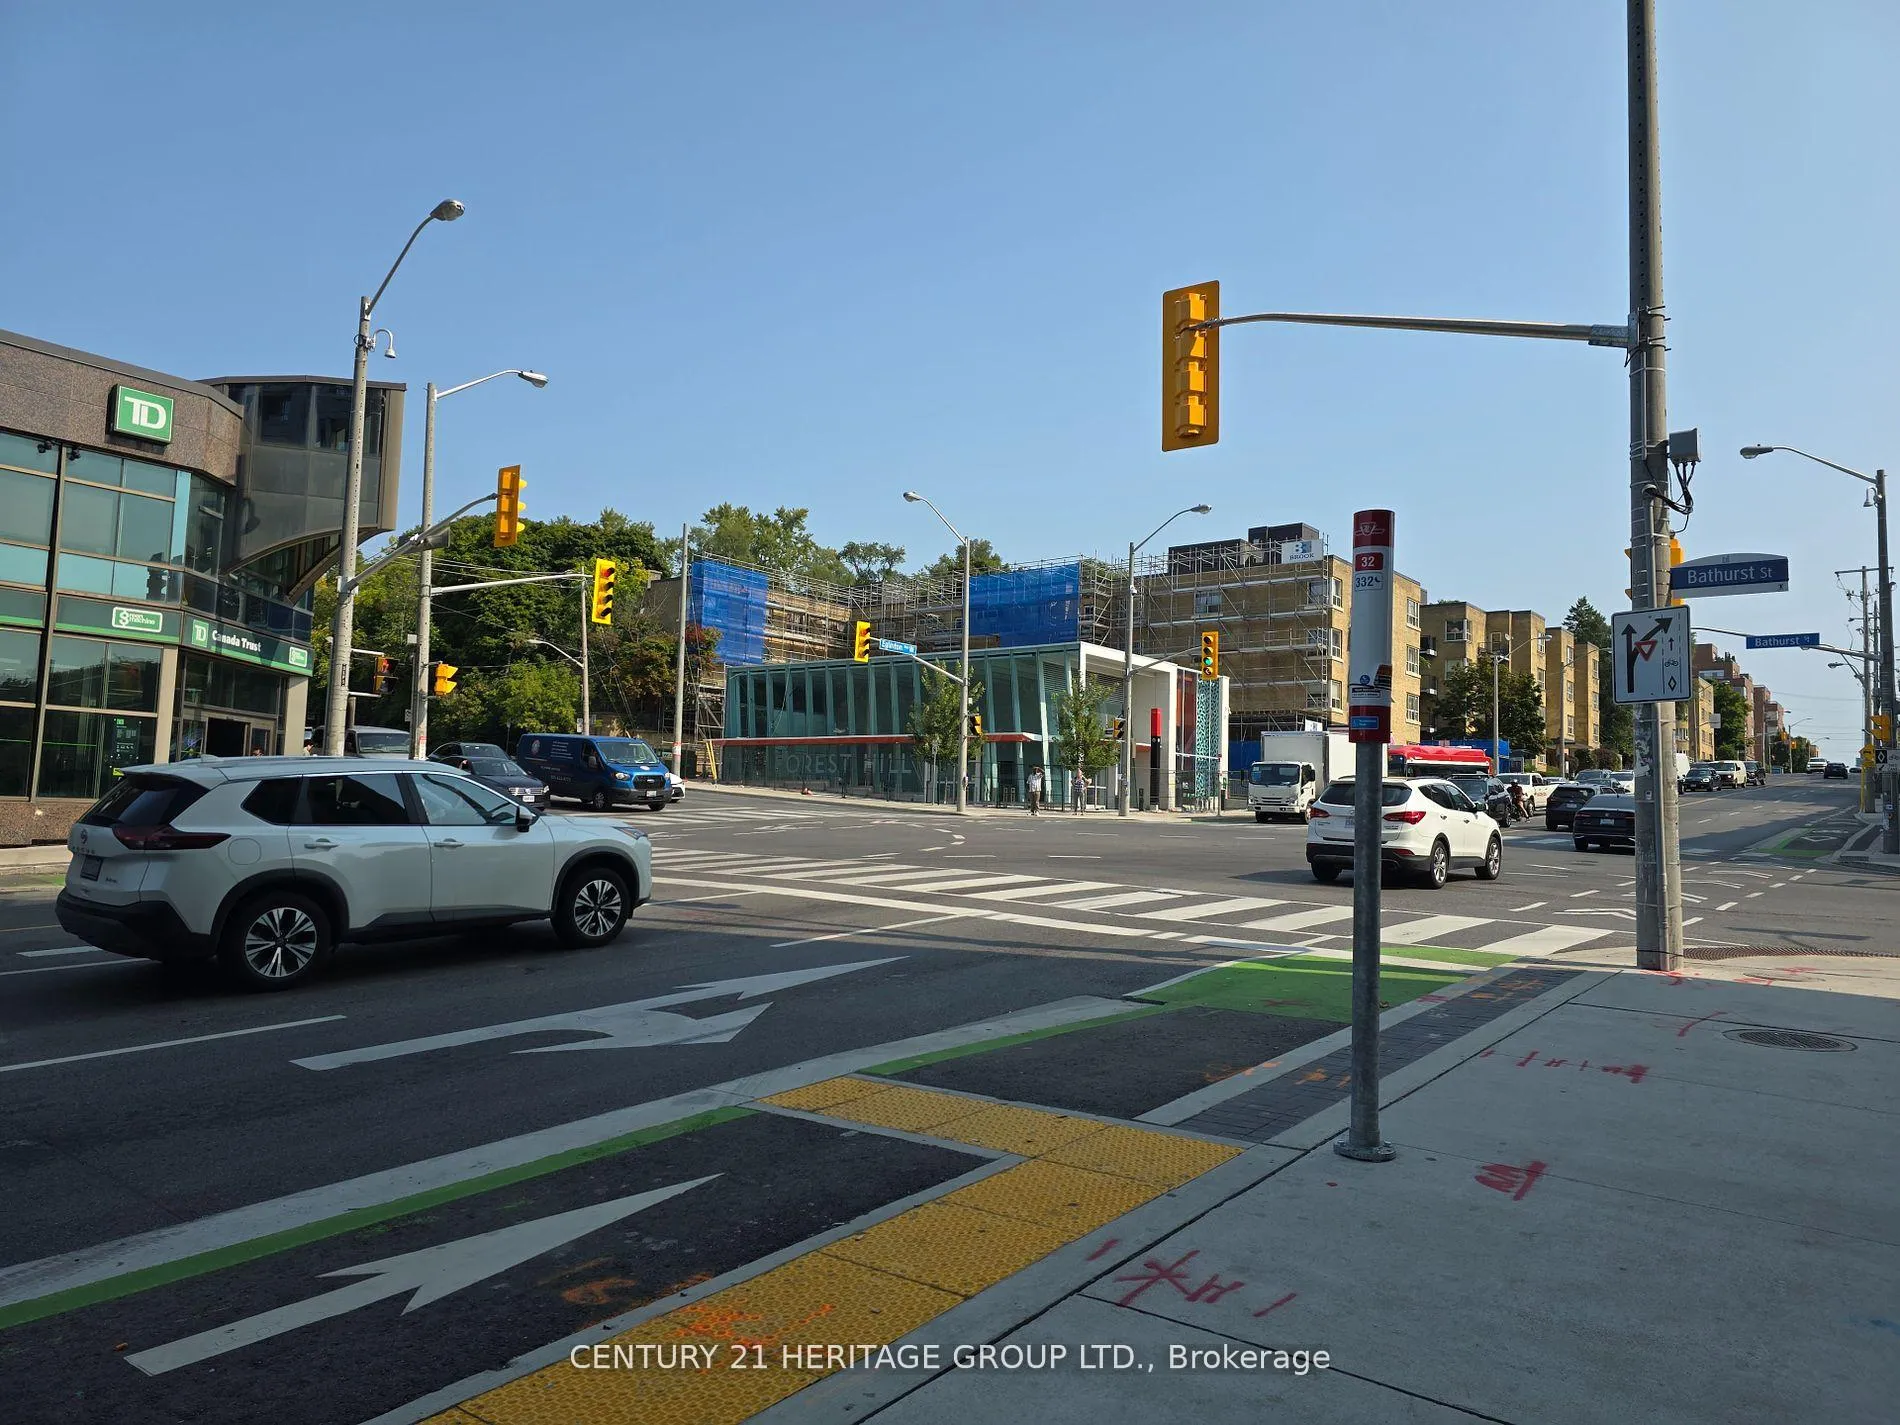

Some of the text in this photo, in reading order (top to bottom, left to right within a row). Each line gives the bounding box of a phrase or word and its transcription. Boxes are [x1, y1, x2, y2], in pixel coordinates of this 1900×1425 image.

[124, 396, 167, 430] TD
[1289, 552, 1315, 561] BROOK
[1361, 556, 1375, 568] 32
[1355, 576, 1374, 588] 332
[1687, 565, 1773, 584] Bathurst St
[194, 624, 207, 642] TD
[211, 629, 262, 652] Canada Trust
[1755, 636, 1800, 647] Bathurst
[777, 753, 852, 774] OREST
